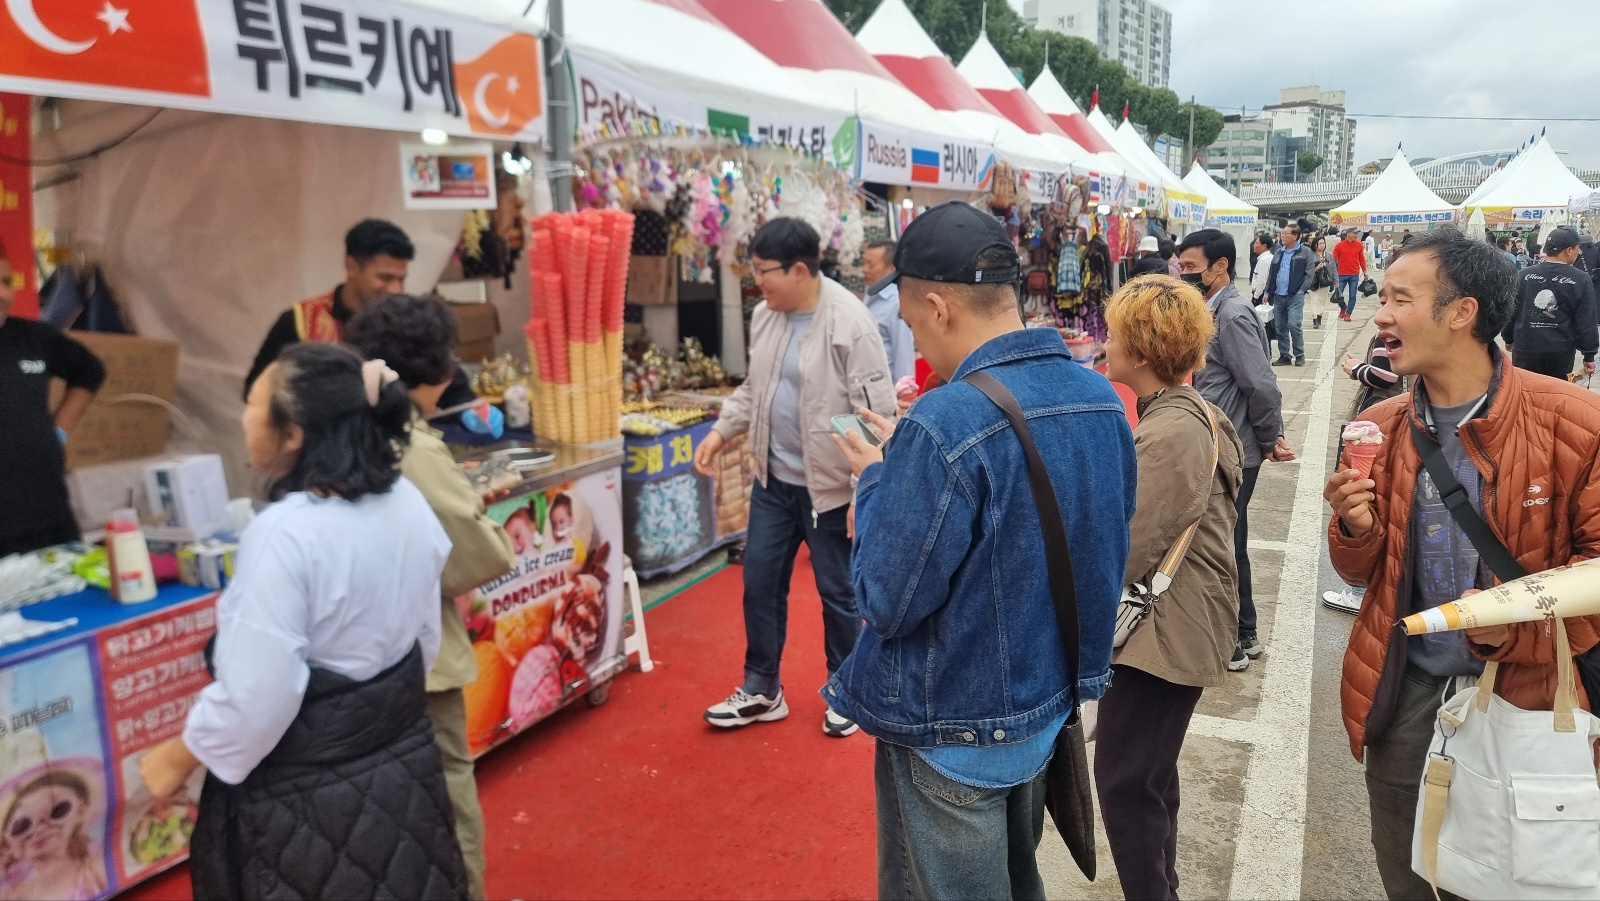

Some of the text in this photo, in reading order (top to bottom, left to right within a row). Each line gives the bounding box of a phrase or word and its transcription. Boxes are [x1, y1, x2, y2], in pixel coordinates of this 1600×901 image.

[233, 0, 463, 117] 튀르키예
[867, 133, 908, 169] Russia
[943, 143, 978, 185] 러시아
[524, 555, 540, 575] ice
[544, 547, 575, 568] cream
[492, 570, 567, 617] DONDURMA
